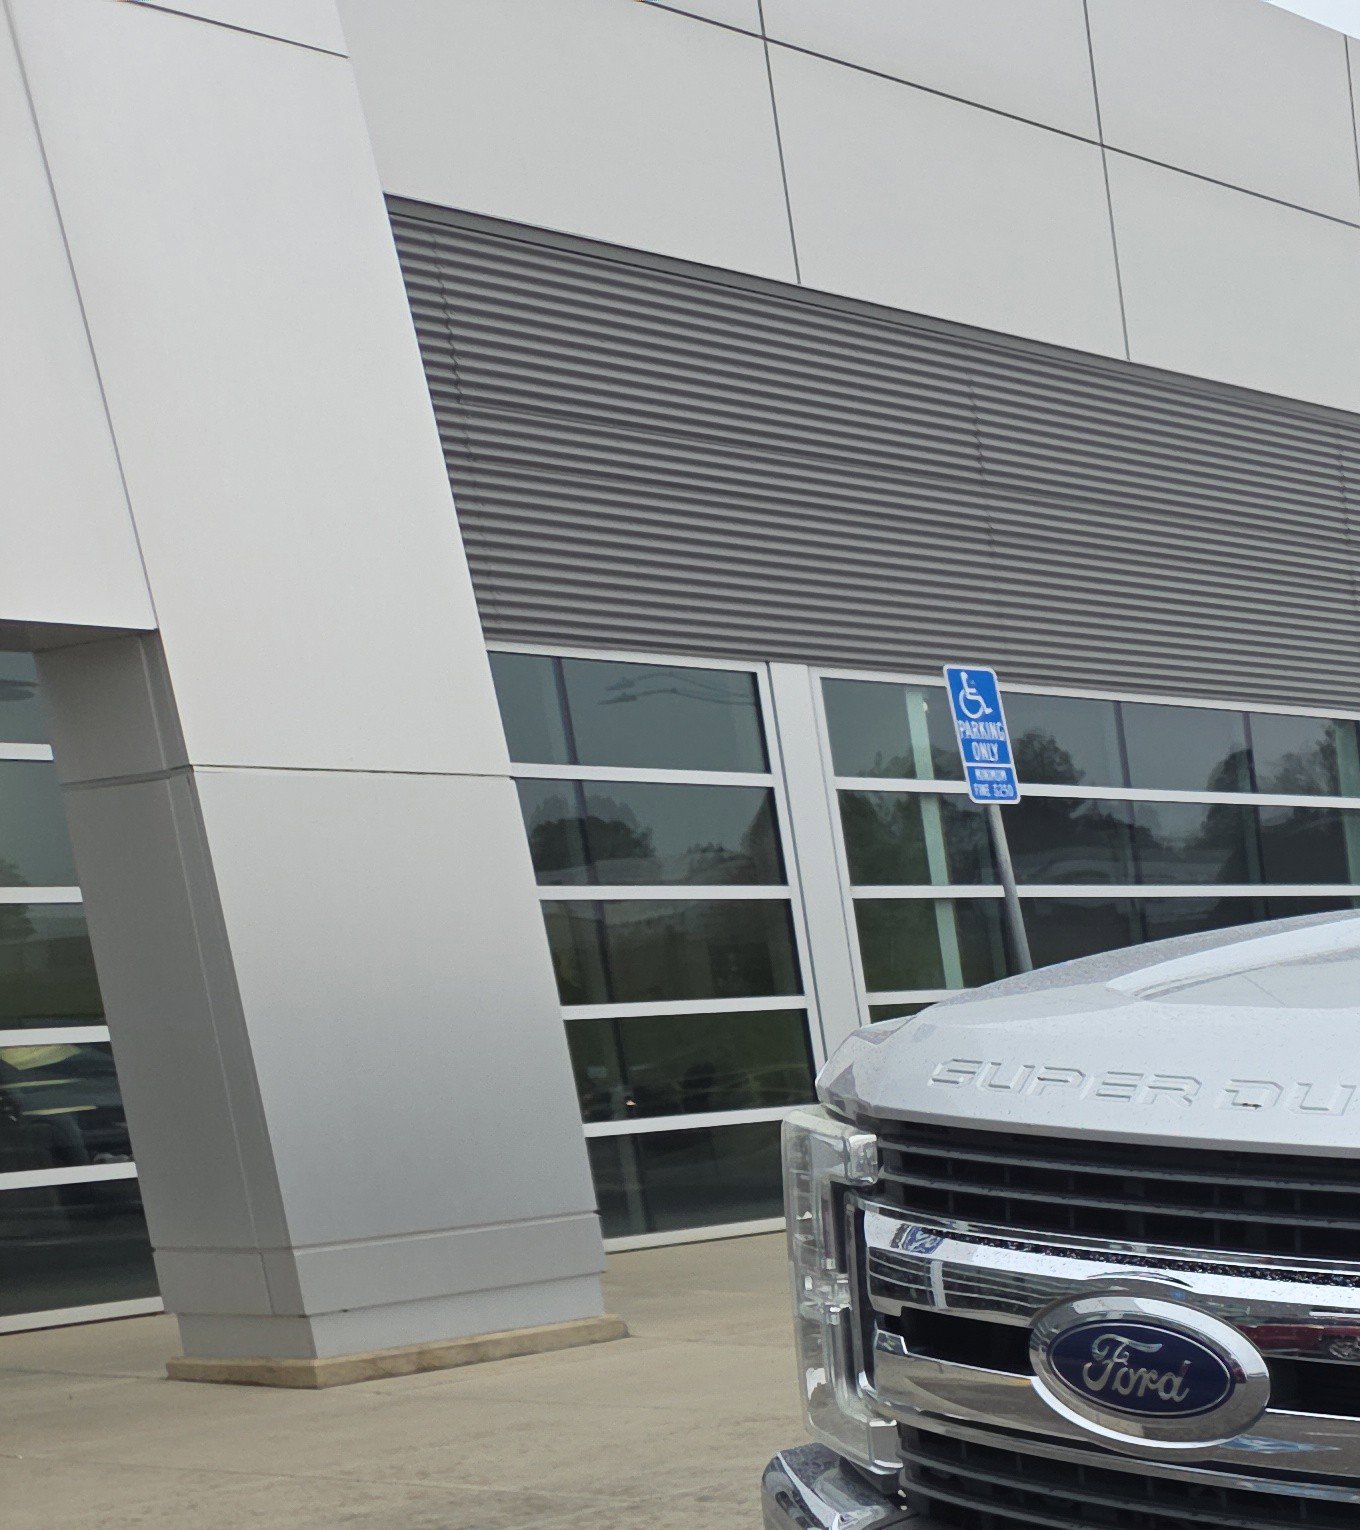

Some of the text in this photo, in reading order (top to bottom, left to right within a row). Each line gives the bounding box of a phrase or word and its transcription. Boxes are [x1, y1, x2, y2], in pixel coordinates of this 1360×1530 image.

[957, 720, 1006, 741] PARKING
[971, 741, 999, 762] ONLY
[928, 1057, 1203, 1107] SUPER
[1082, 1333, 1192, 1402] Ford
